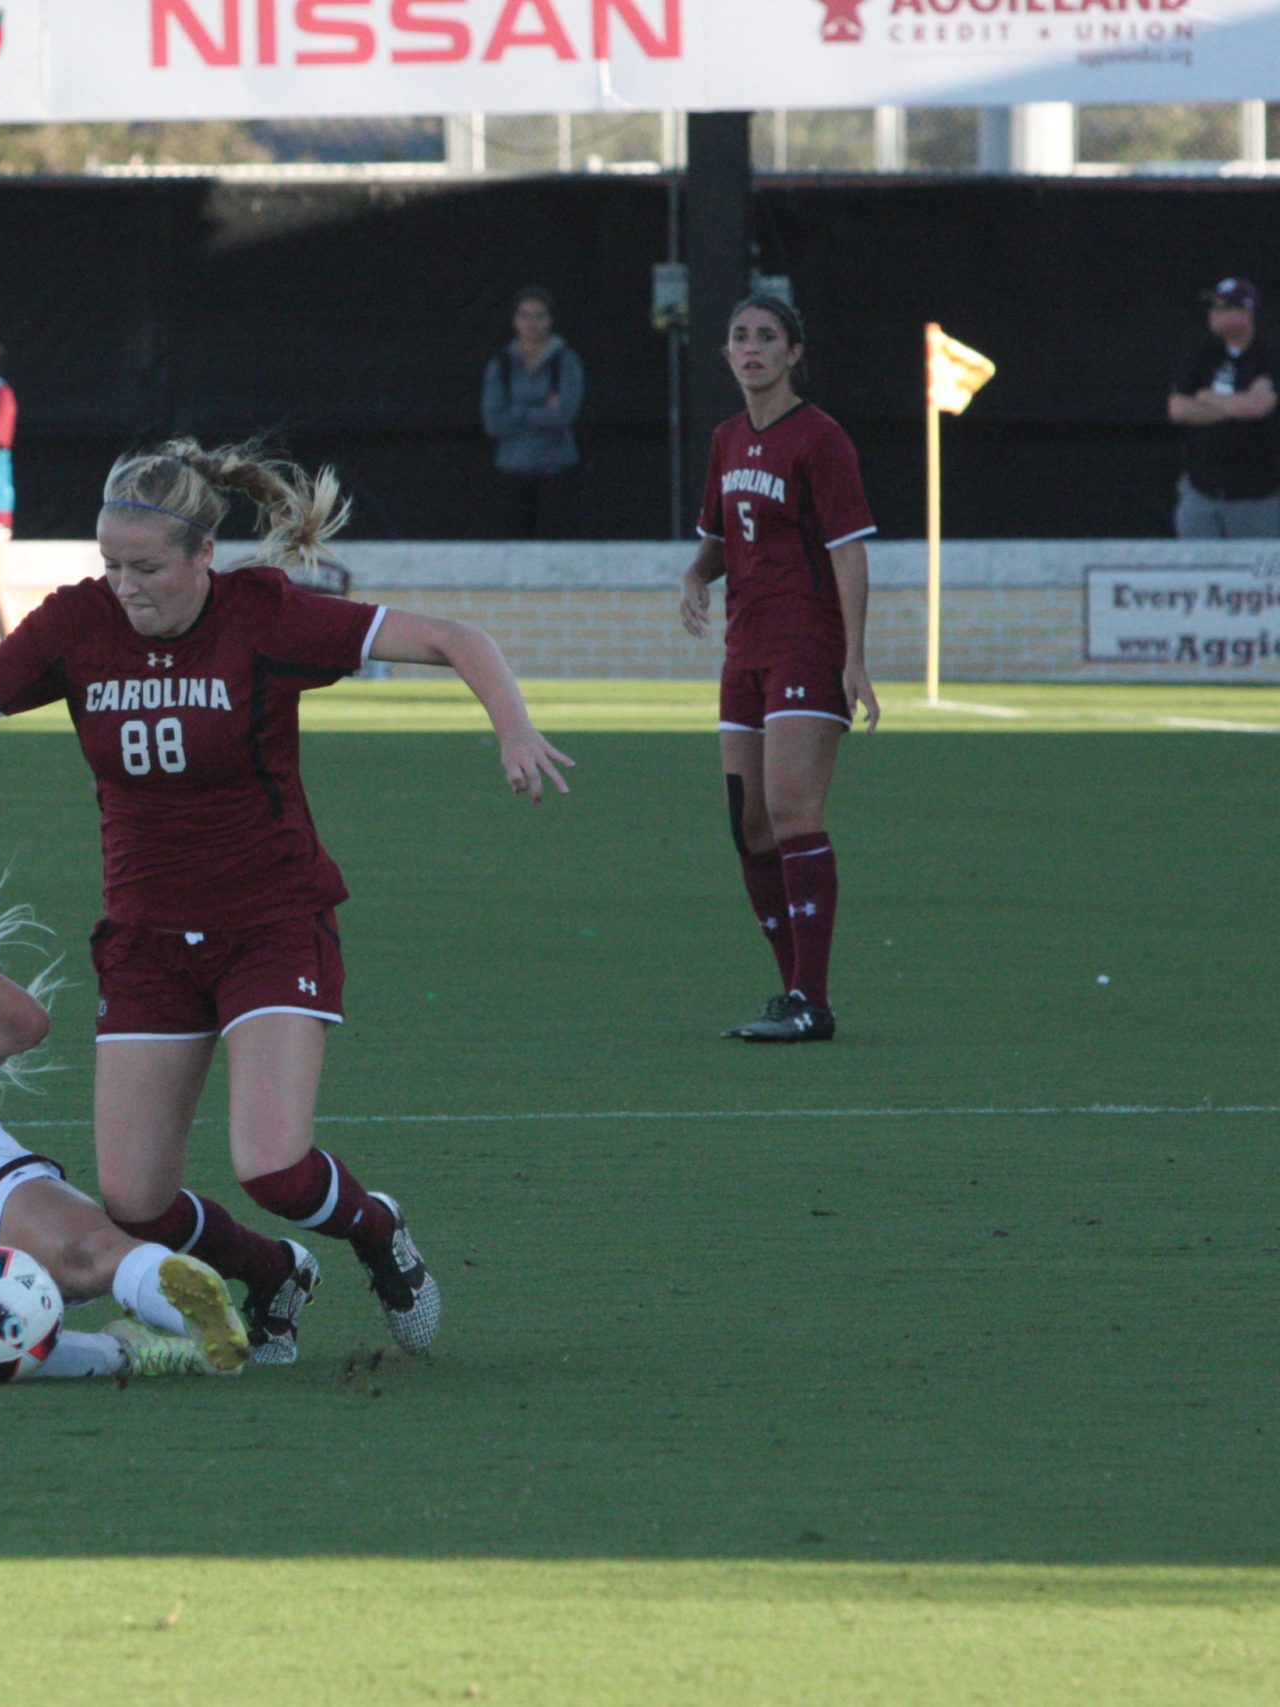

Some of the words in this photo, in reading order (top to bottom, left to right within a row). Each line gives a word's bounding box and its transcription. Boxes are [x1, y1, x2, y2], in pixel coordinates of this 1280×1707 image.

[151, 0, 683, 67] NISSAN
[888, 21, 1011, 43] CREDIT
[1075, 20, 1196, 42] UNION
[736, 501, 756, 542] 5
[1114, 583, 1198, 617] Every
[85, 677, 233, 712] CAROLINA
[120, 717, 187, 776] 88
